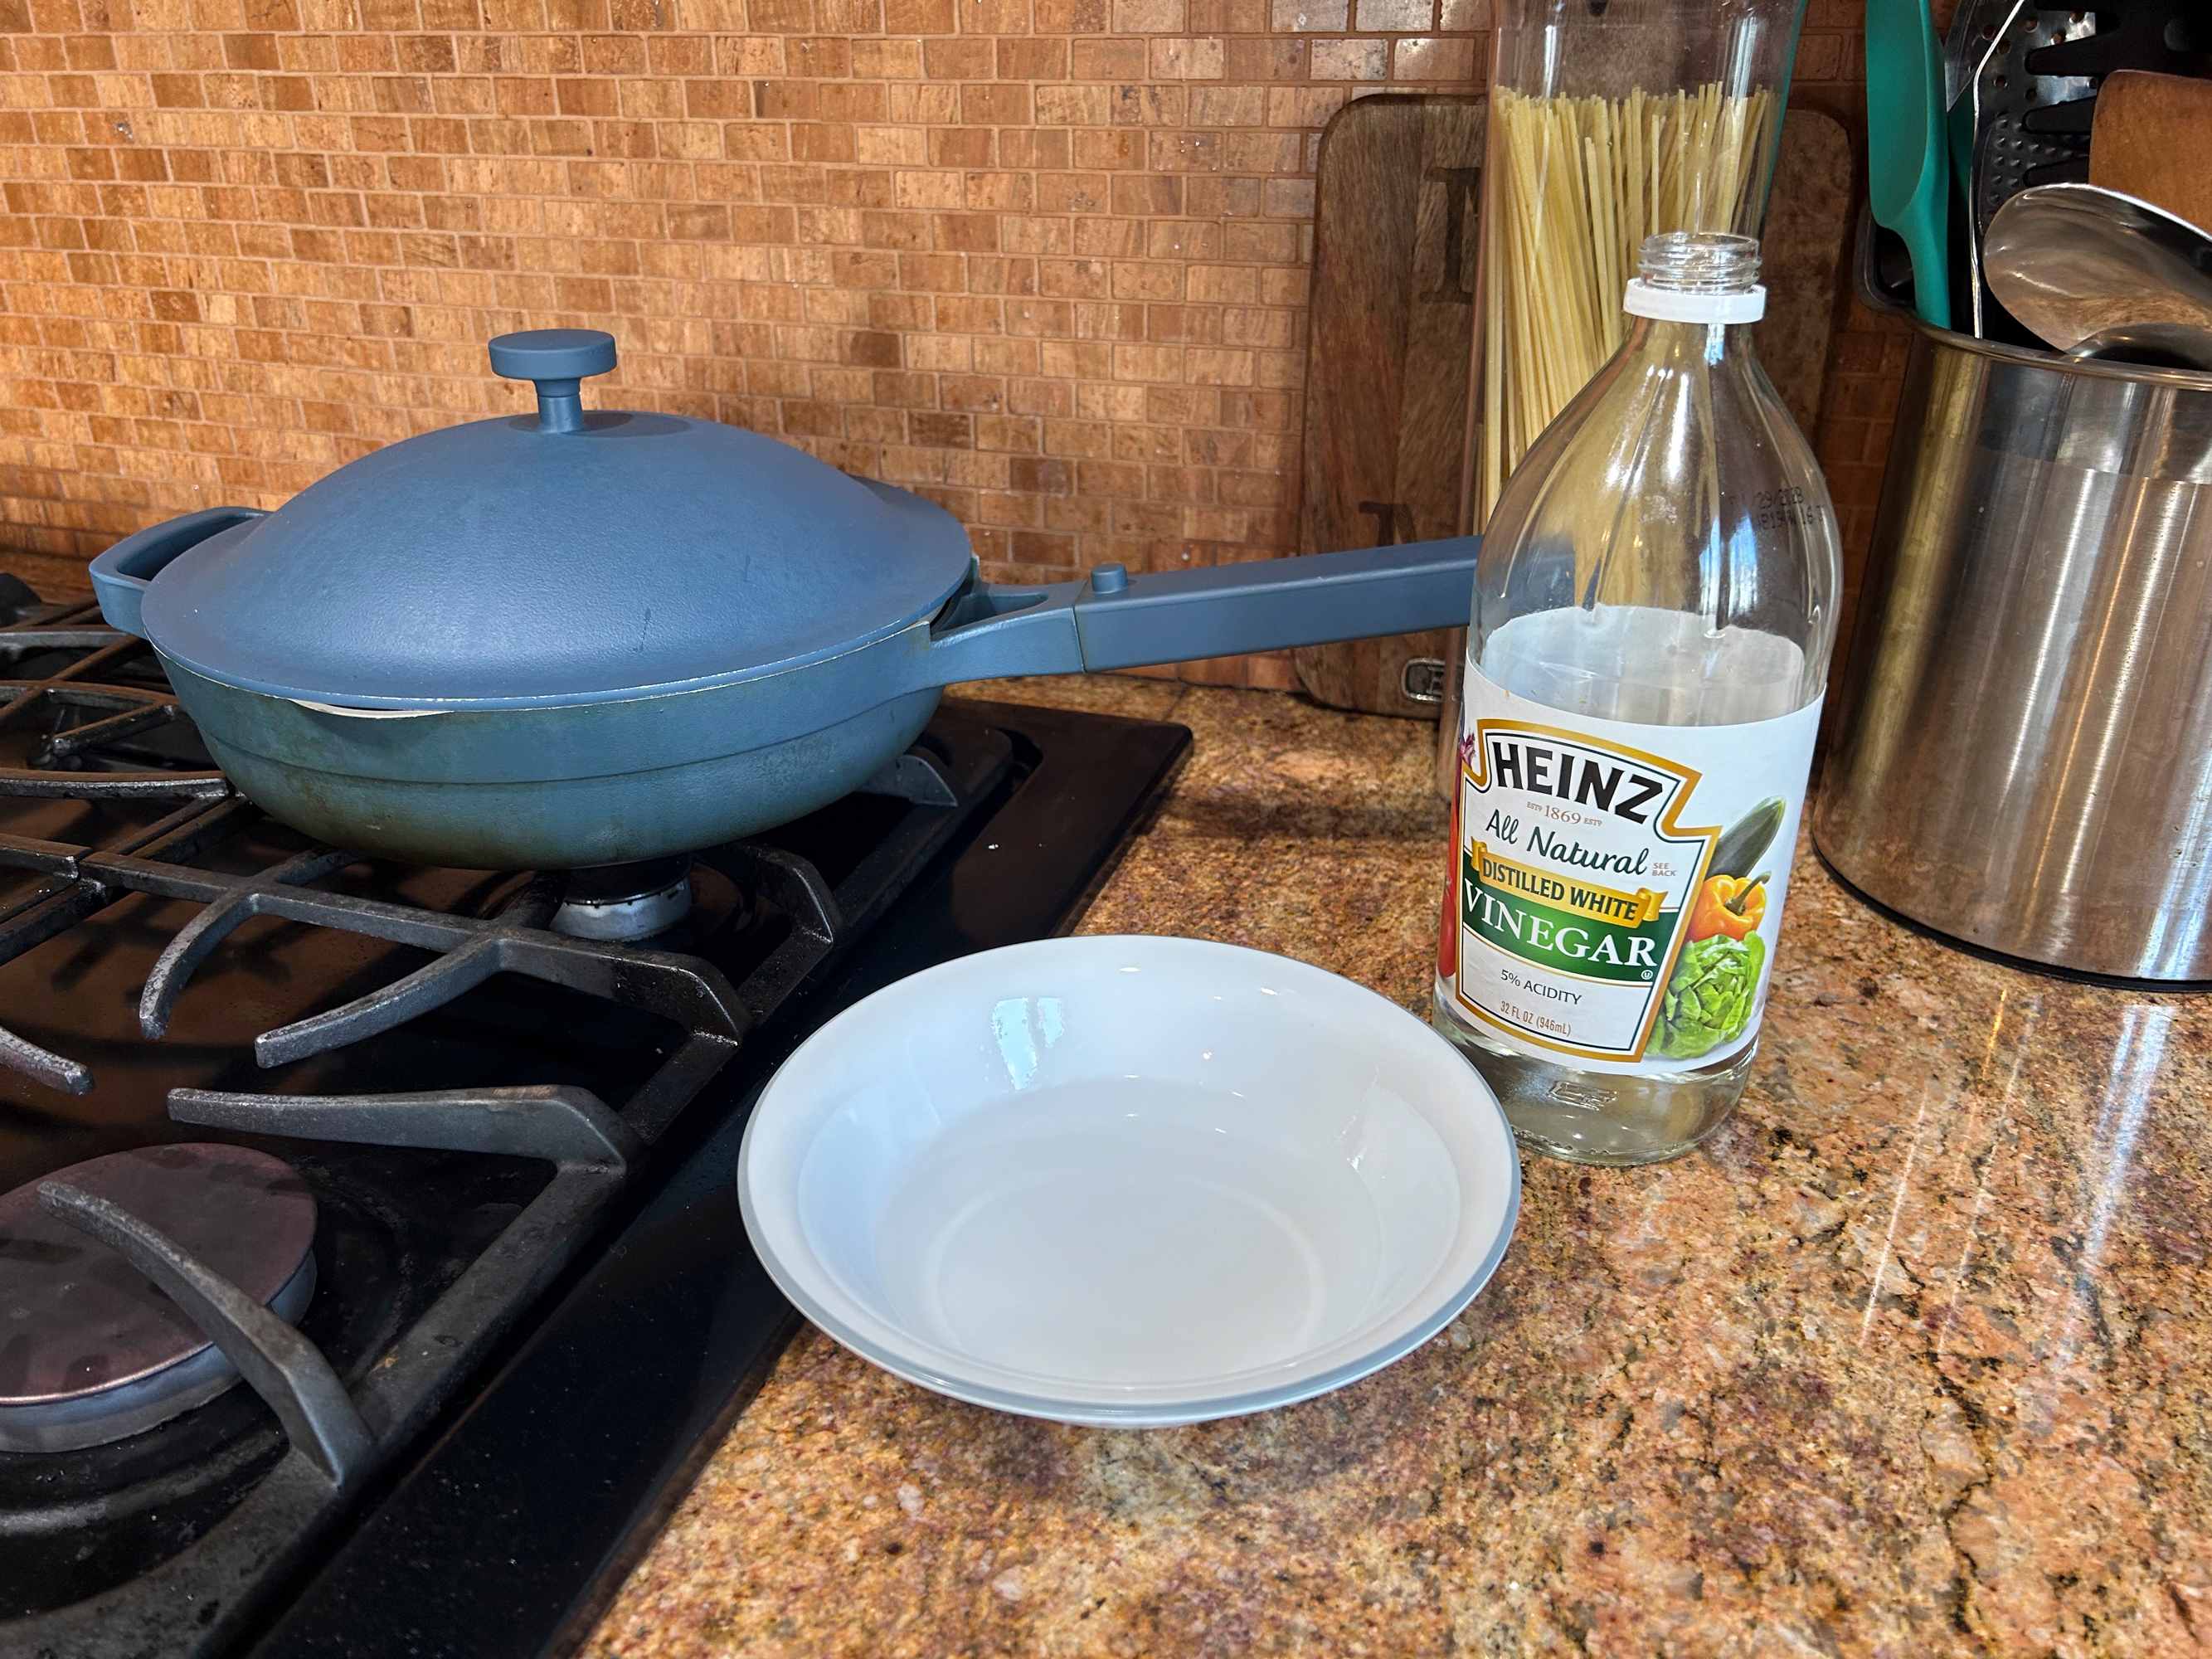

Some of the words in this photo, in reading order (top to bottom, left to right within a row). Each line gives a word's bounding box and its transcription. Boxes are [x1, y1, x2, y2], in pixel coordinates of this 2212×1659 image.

[1492, 742, 1663, 825] HEINZ
[1544, 805, 1582, 825] 1869
[1485, 809, 1519, 844] All
[1526, 826, 1649, 875] Natural
[1482, 858, 1565, 902] DISTILLED
[1570, 887, 1640, 921] WHITE
[1464, 878, 1658, 967] VINEGAR
[1500, 969, 1521, 987] 5%
[1524, 980, 1582, 1005] ACIDITY
[1500, 1000, 1510, 1014] 32
[1511, 1005, 1520, 1019] FL
[1523, 1011, 1534, 1024] OZ
[1536, 1016, 1572, 1037] (946mL)
